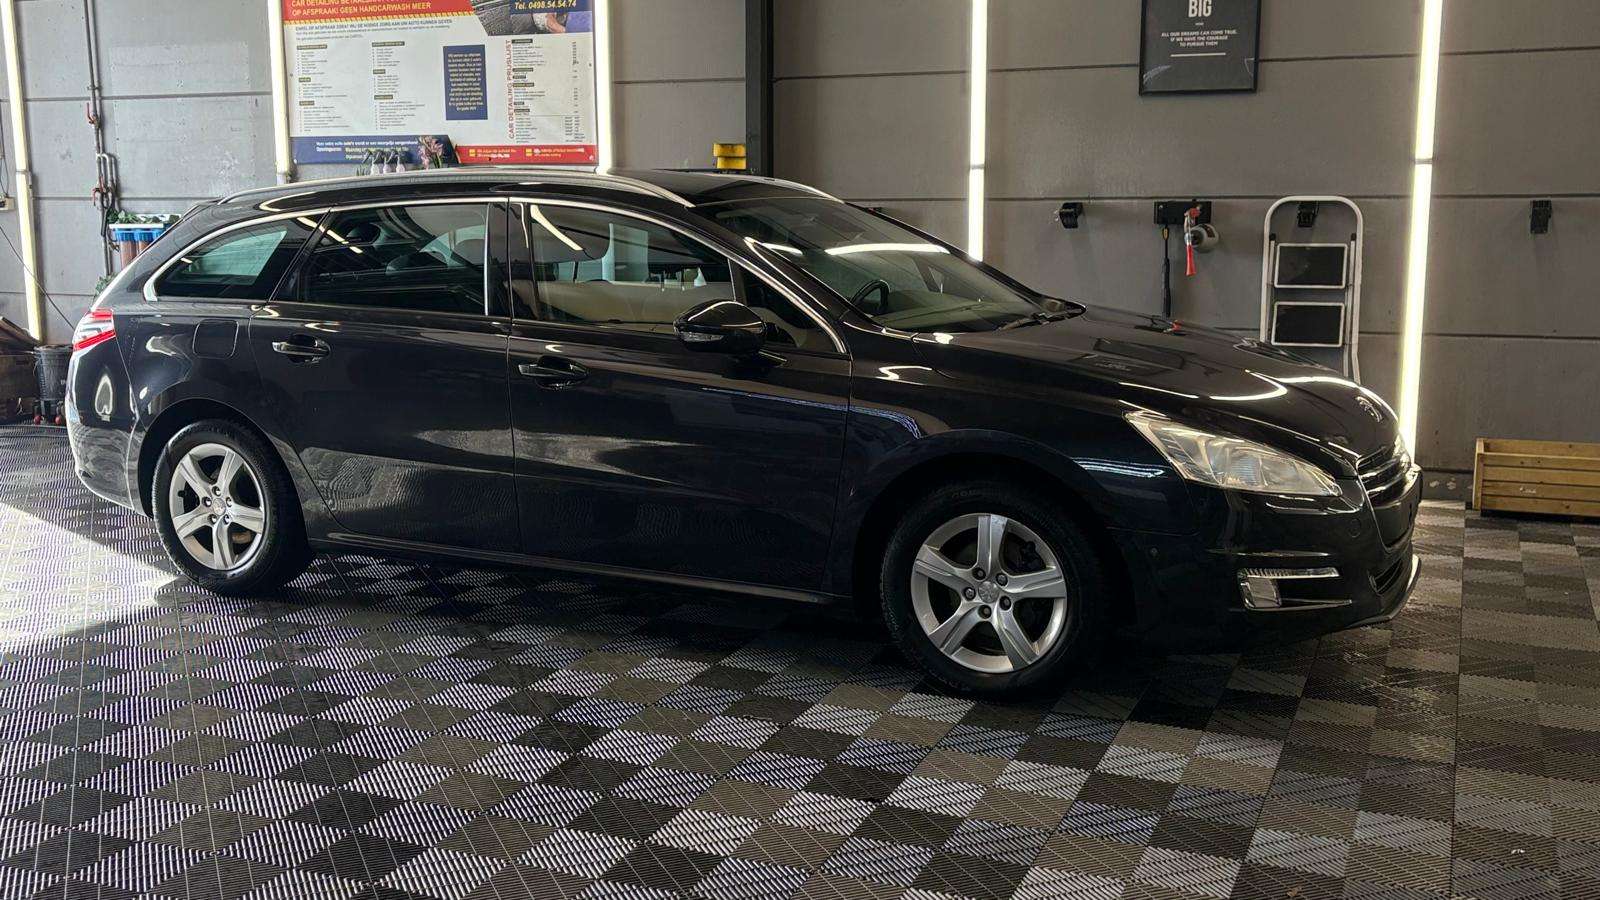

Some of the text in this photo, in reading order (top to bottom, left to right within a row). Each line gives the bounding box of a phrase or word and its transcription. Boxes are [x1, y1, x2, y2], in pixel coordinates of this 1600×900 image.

[292, 2, 432, 17] OP AFSPRAAK! GEEN HANDCARWASH MEER
[1188, 0, 1212, 18] BIG
